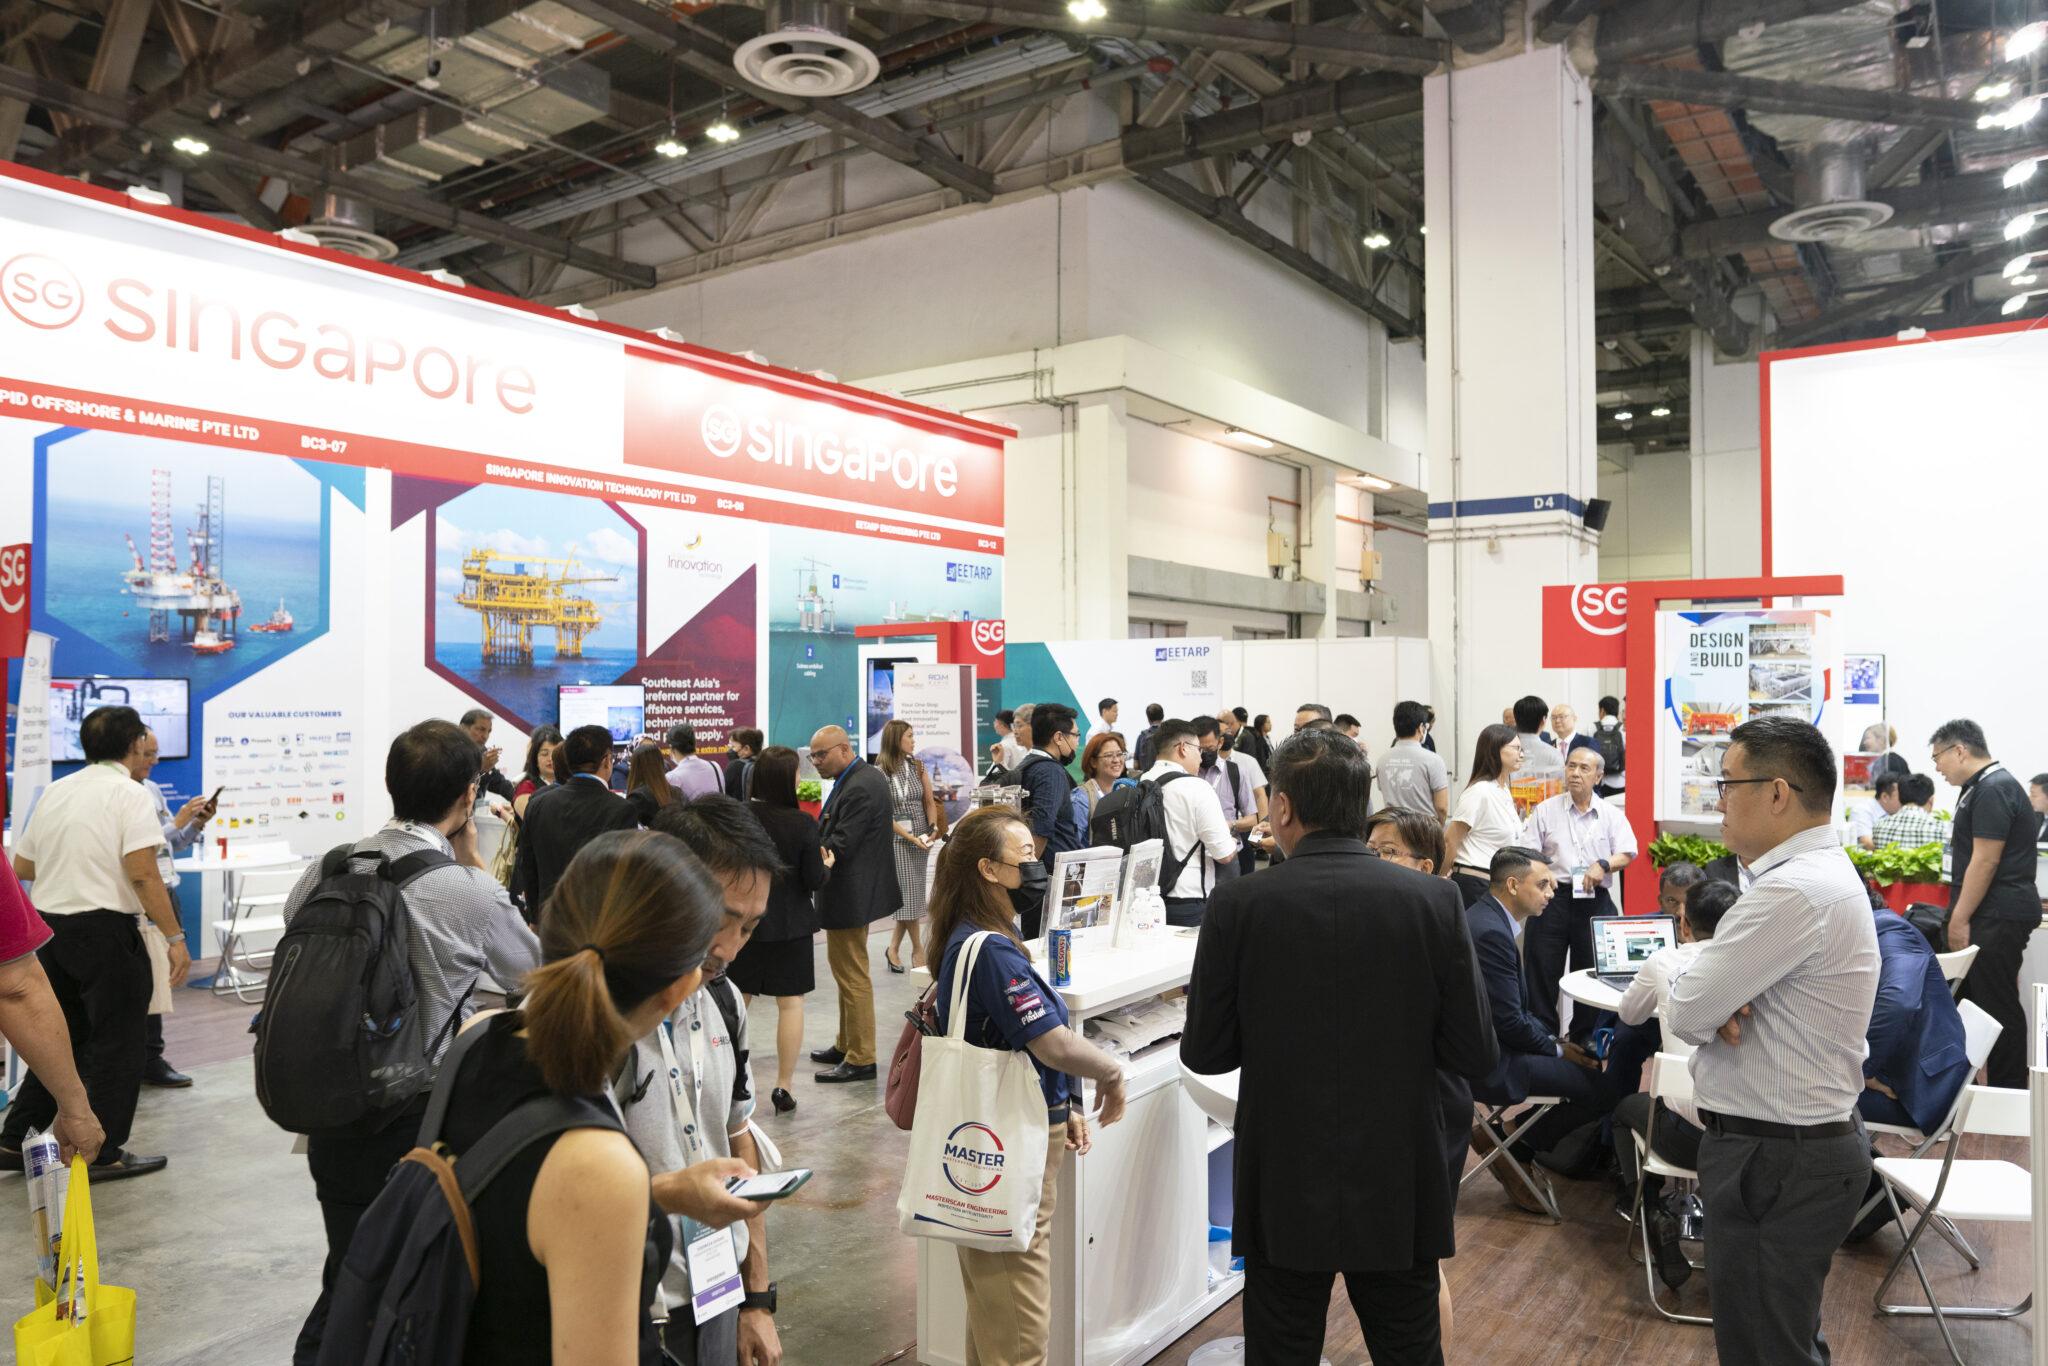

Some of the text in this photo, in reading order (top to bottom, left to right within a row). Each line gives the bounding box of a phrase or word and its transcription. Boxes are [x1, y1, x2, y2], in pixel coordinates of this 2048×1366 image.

[11, 272, 75, 311] SG
[31, 394, 121, 421] OFFSHORE
[124, 409, 136, 423] &
[138, 410, 200, 433] MARINE
[202, 420, 233, 438] PTE
[233, 424, 259, 441] LTD
[300, 435, 347, 454] BC3-07
[485, 463, 696, 505] SINGAPORE INNOVATION TECHNOLOGY PTE LTD
[919, 529, 930, 539] PTE
[0, 548, 26, 588] SG
[668, 554, 723, 574] Innovation
[957, 563, 993, 581] EETARP
[1581, 586, 1627, 616] SG
[976, 621, 1004, 643] SG
[1690, 632, 1744, 648] DESIGN
[1168, 646, 1210, 657] EETARP
[1700, 652, 1743, 667] BUILD
[641, 677, 720, 689] Southeast Asia's
[689, 692, 725, 703] partner
[726, 691, 740, 702] for
[645, 703, 725, 715] ffshore services,
[645, 717, 734, 727] echnical resources
[695, 729, 723, 743] upply.
[944, 1143, 1005, 1167] MASTER
[925, 1193, 1008, 1215] MASTERSCAN ENGINEERING
